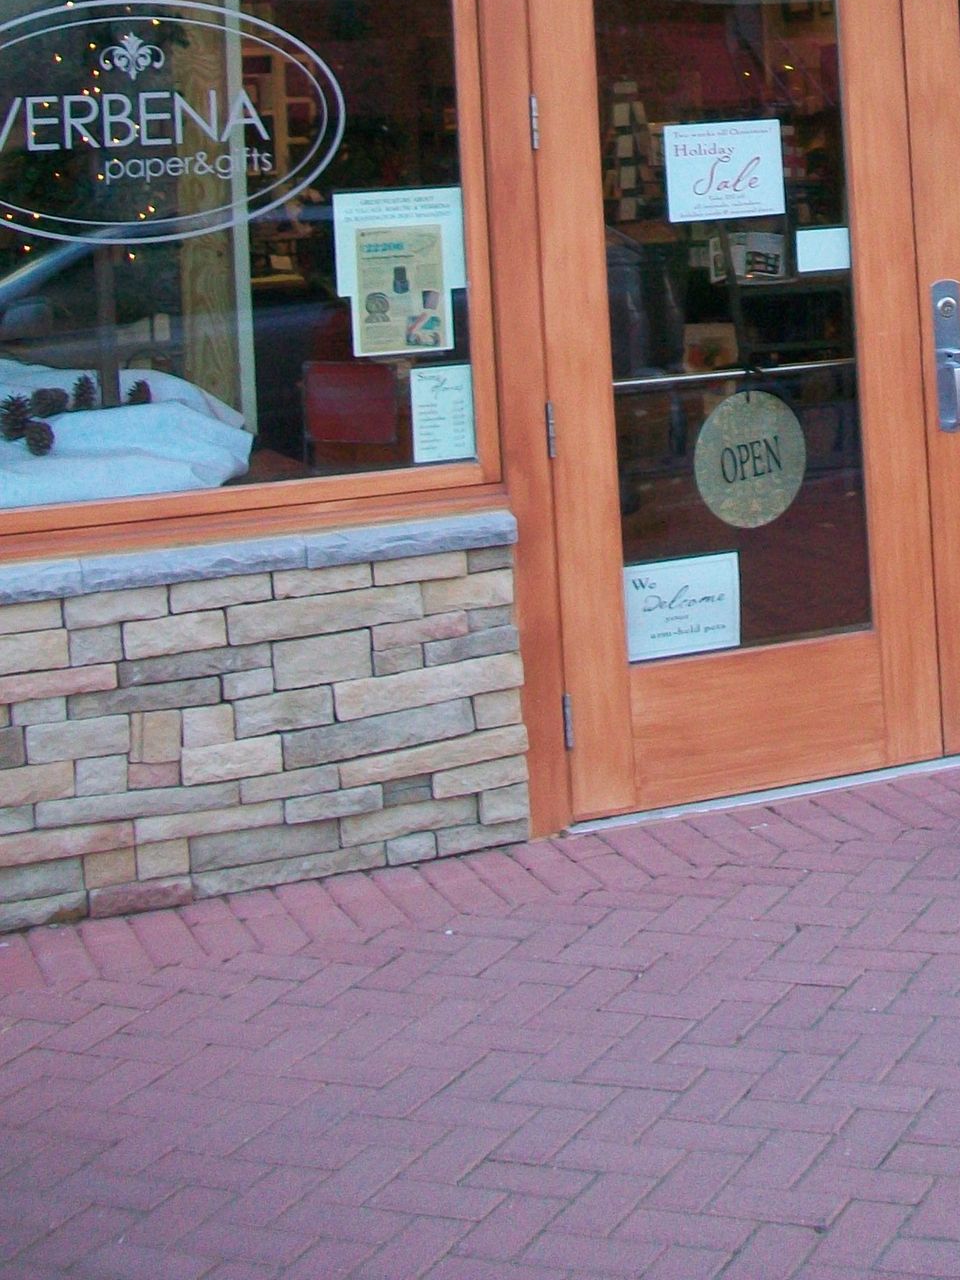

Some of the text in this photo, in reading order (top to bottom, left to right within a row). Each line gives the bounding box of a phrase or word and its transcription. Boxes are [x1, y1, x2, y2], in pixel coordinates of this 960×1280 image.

[673, 143, 735, 157] Holiday
[693, 154, 761, 196] Sale
[721, 435, 783, 484] OPEN
[632, 577, 657, 591] We
